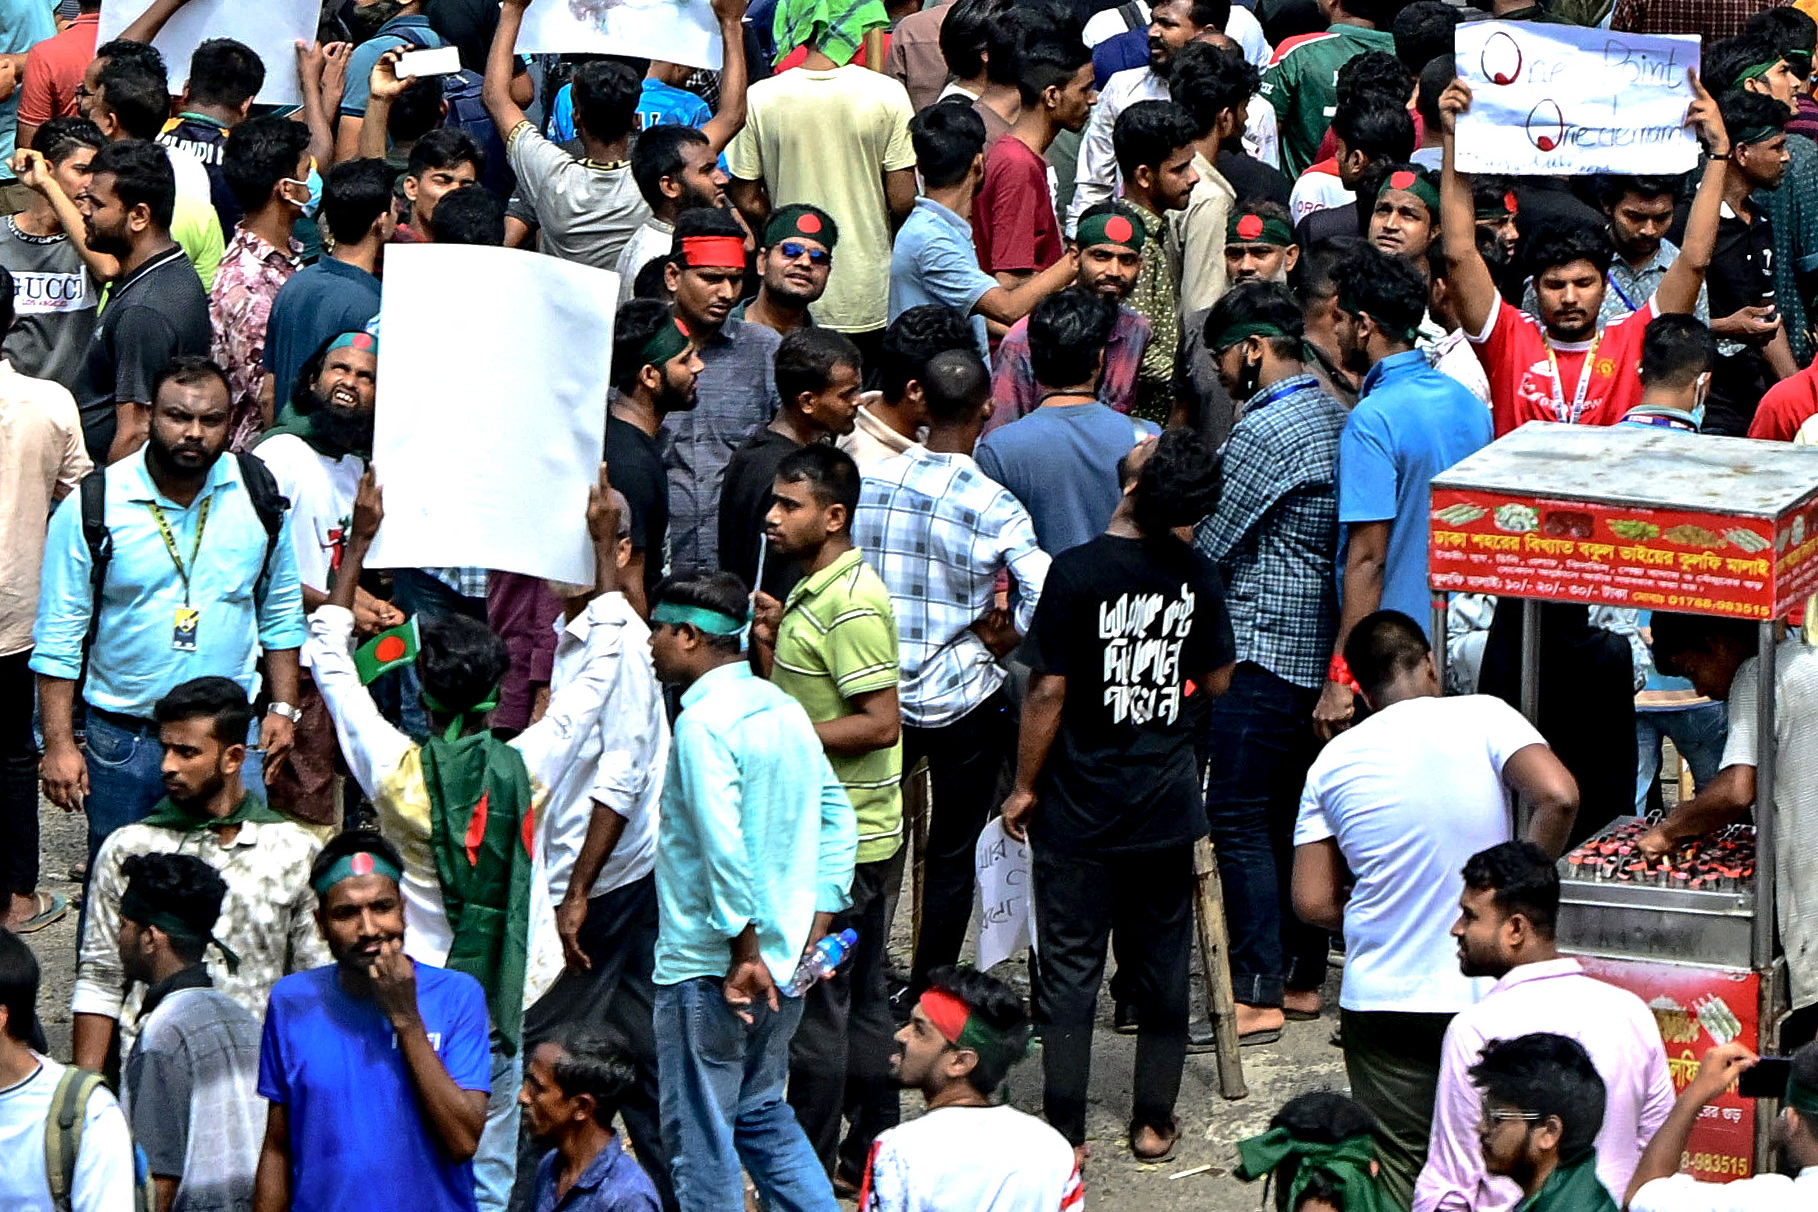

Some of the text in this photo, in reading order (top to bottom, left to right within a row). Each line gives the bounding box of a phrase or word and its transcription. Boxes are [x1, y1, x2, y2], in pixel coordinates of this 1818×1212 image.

[1432, 530, 1467, 549] ঢাকা
[1470, 533, 1521, 551] শহরের
[1523, 532, 1575, 556] বিখ্যাত
[1725, 556, 1771, 578] মালাই
